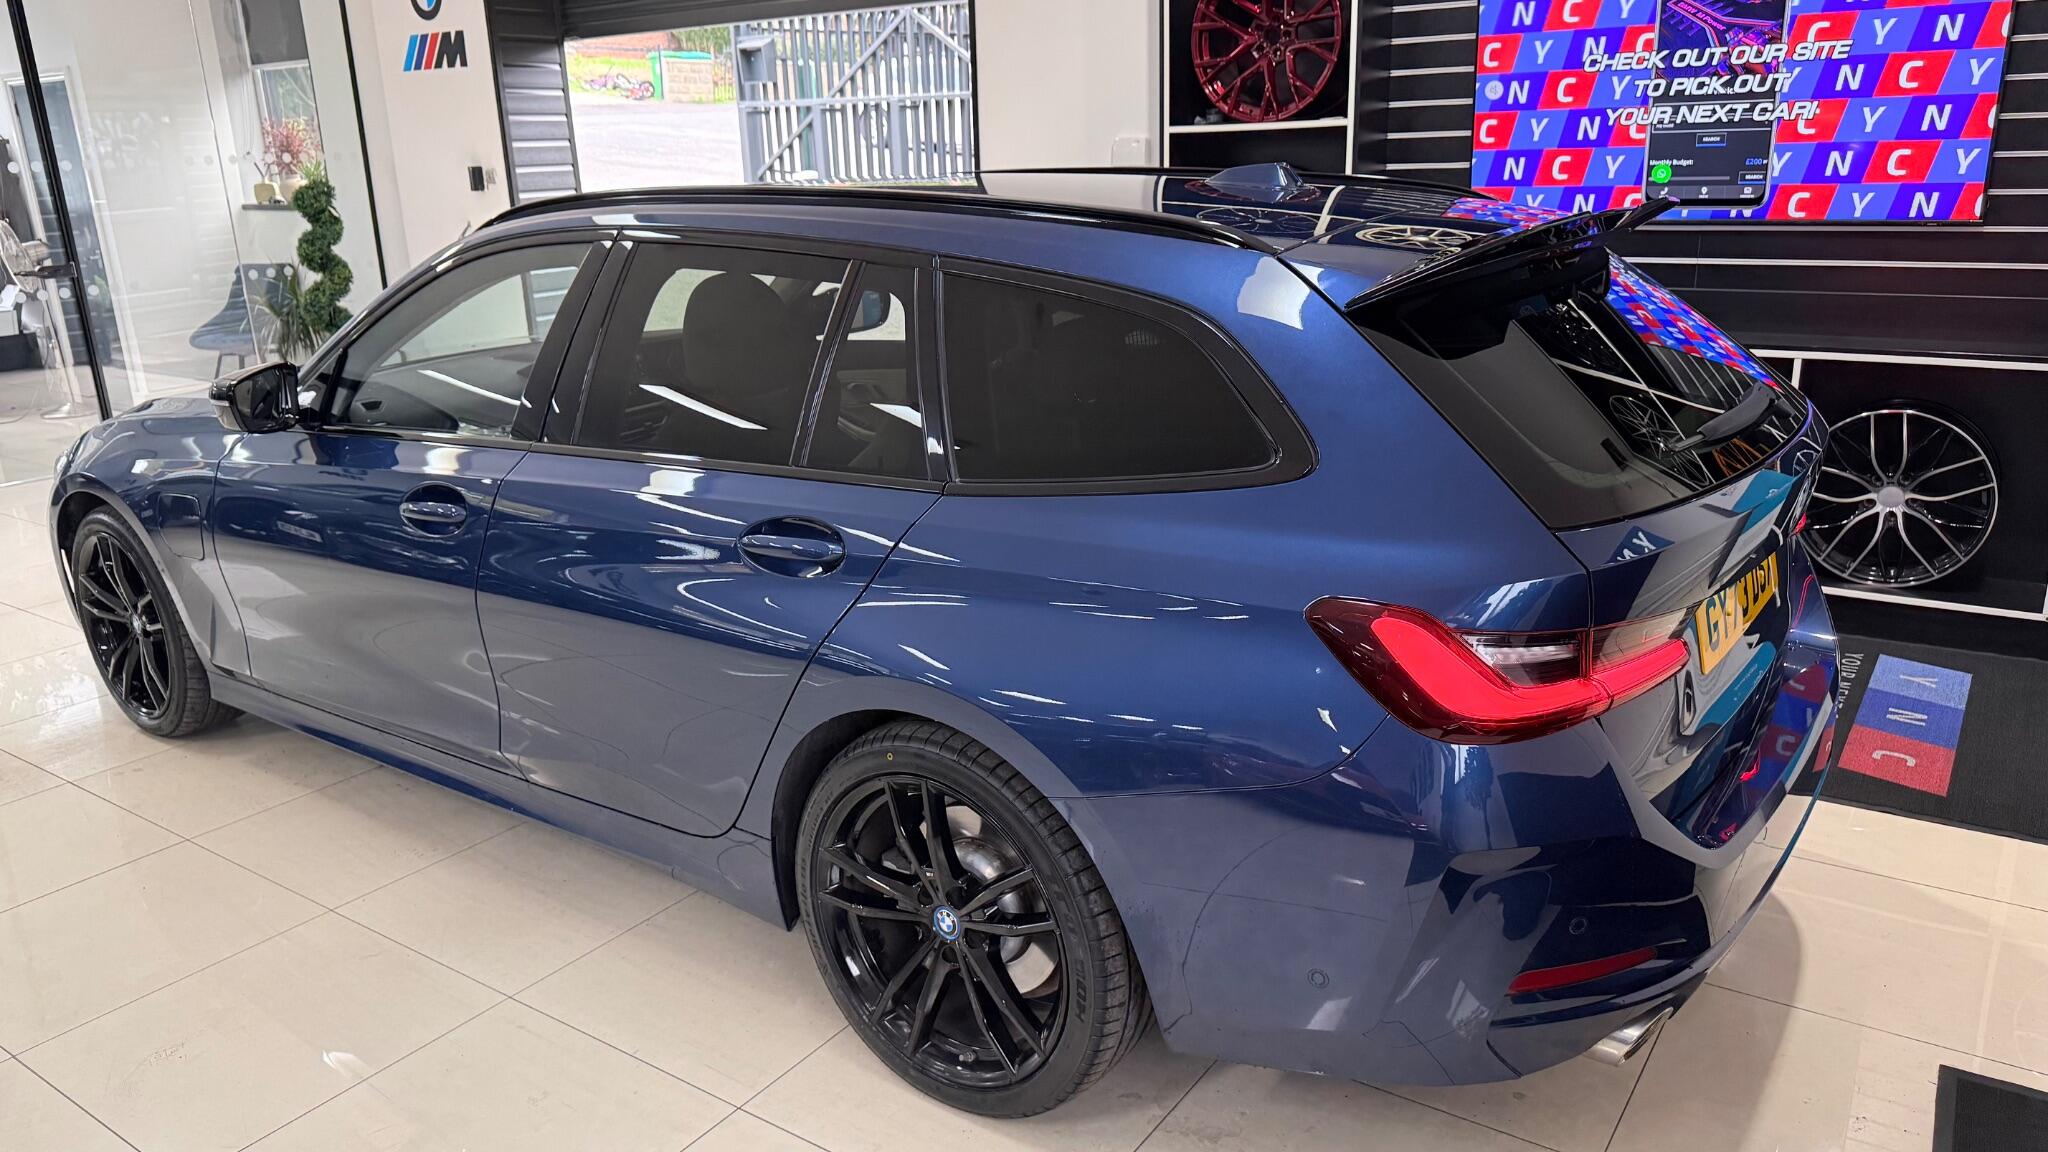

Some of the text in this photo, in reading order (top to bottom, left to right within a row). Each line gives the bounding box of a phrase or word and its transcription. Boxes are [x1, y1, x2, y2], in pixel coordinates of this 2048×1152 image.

[1512, 1, 1536, 27] N
[1562, 0, 1583, 23] C
[1483, 42, 1502, 68] C
[1534, 39, 1554, 65] Y
[1873, 17, 1898, 46] Y
[1932, 13, 1966, 43] N
[1583, 39, 1854, 73] CHECK OUT OUR SITE
[1506, 80, 1530, 105] N
[1556, 77, 1577, 103] C
[1611, 75, 1632, 100] Y
[1834, 63, 1865, 91] N
[1898, 60, 1924, 89] C
[1969, 57, 1995, 86] Y
[1633, 78, 1667, 98] TO
[1668, 75, 1732, 97] PICK
[1733, 73, 1792, 93] OUT
[1479, 118, 1498, 144] C
[1530, 117, 1549, 142] Y
[1576, 115, 1601, 141] N
[1862, 106, 1888, 133] Y
[1920, 103, 1953, 132] N
[1605, 107, 1674, 126] YOUR
[1675, 103, 1752, 124] NEXT
[1503, 157, 1526, 181] N
[1551, 155, 1572, 181] C
[1605, 154, 1626, 180] Y
[1824, 150, 1854, 177] N
[1886, 148, 1912, 177] C
[1956, 147, 1982, 175] Y
[1745, 158, 1763, 166] £200
[1787, 191, 1811, 218] C
[1851, 192, 1876, 218] Y
[1908, 191, 1940, 218] N
